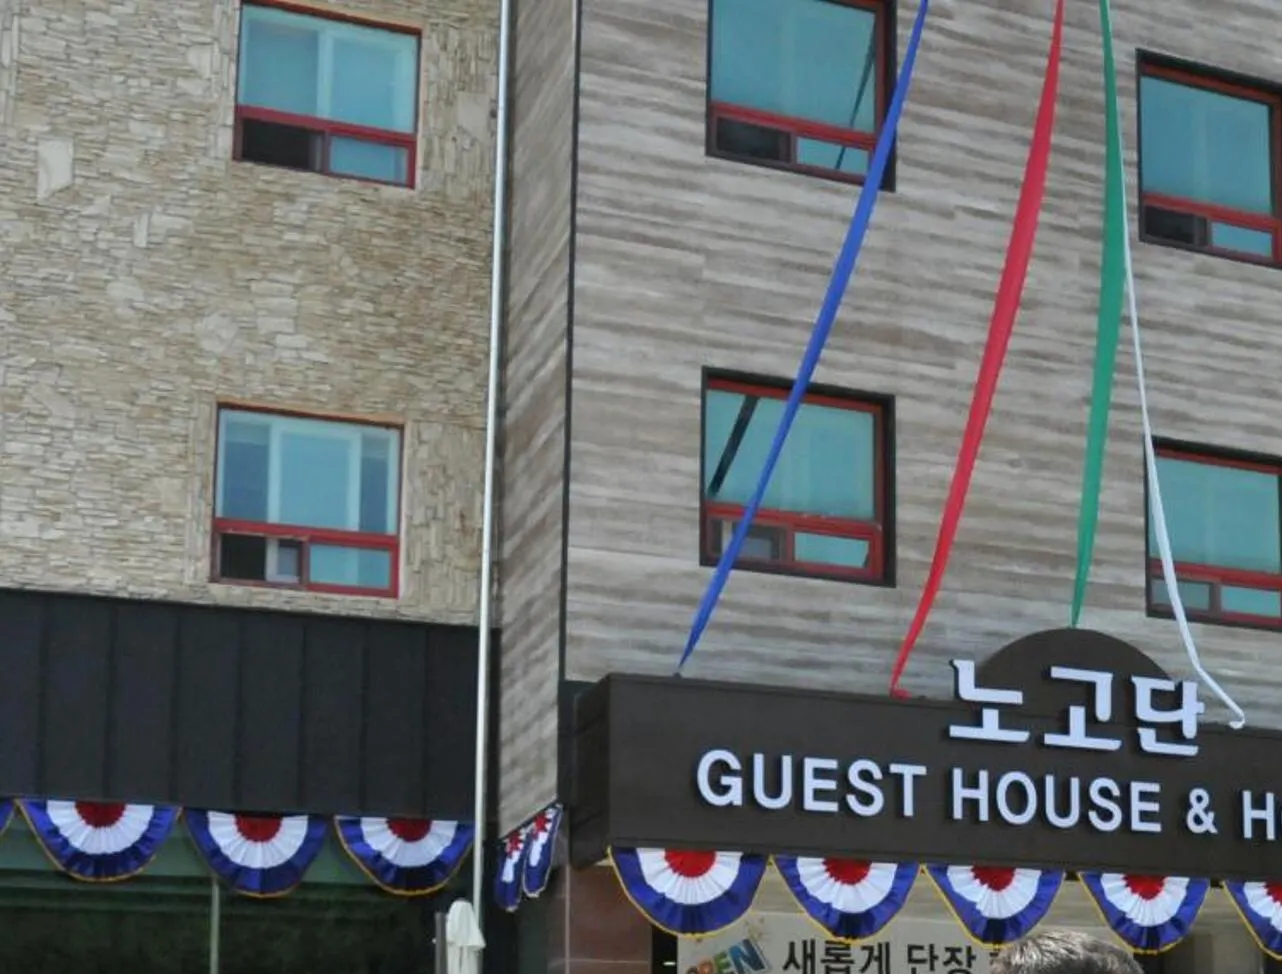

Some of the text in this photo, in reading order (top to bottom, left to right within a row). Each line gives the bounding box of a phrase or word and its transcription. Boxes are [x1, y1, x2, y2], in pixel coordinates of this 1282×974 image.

[949, 659, 1205, 757] 노고단
[696, 748, 928, 818] GUEST
[952, 767, 1162, 833] HOUSE
[1186, 787, 1218, 835] &
